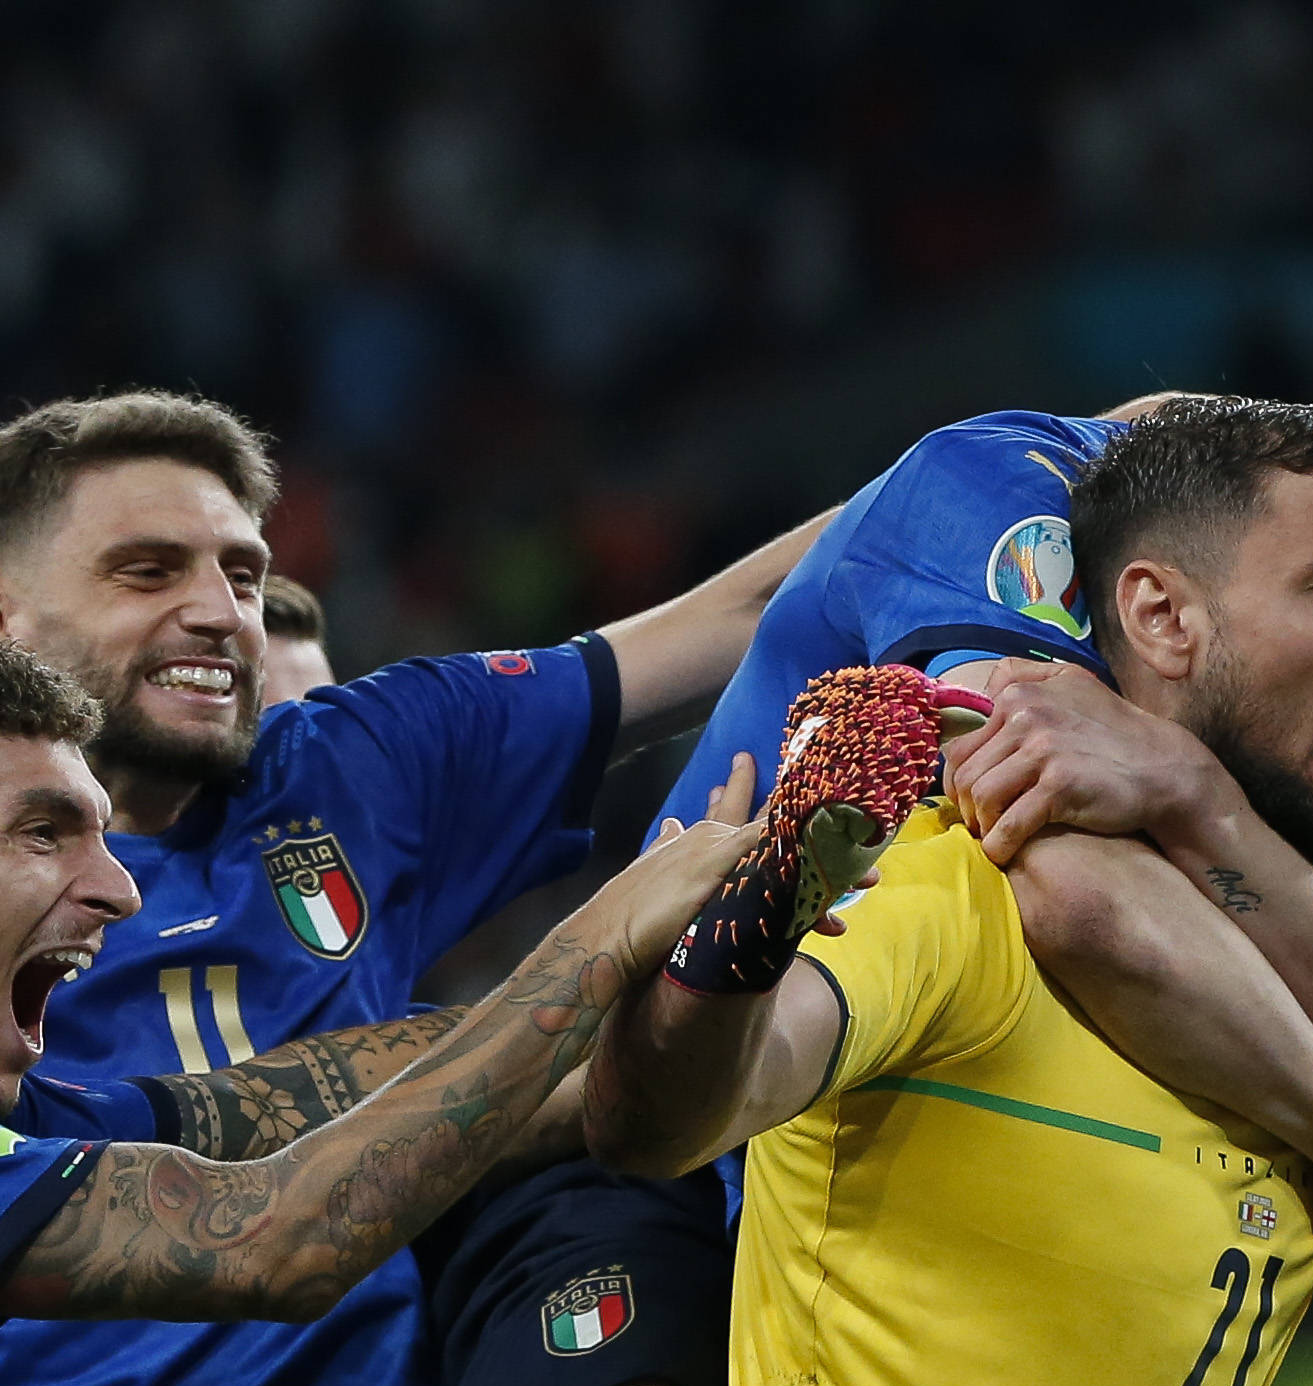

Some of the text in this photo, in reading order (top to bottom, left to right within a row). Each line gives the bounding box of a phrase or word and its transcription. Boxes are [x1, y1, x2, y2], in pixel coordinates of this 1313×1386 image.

[267, 845, 334, 875] ITALIA
[158, 964, 255, 1074] 11
[550, 1280, 621, 1315] ITALIA
